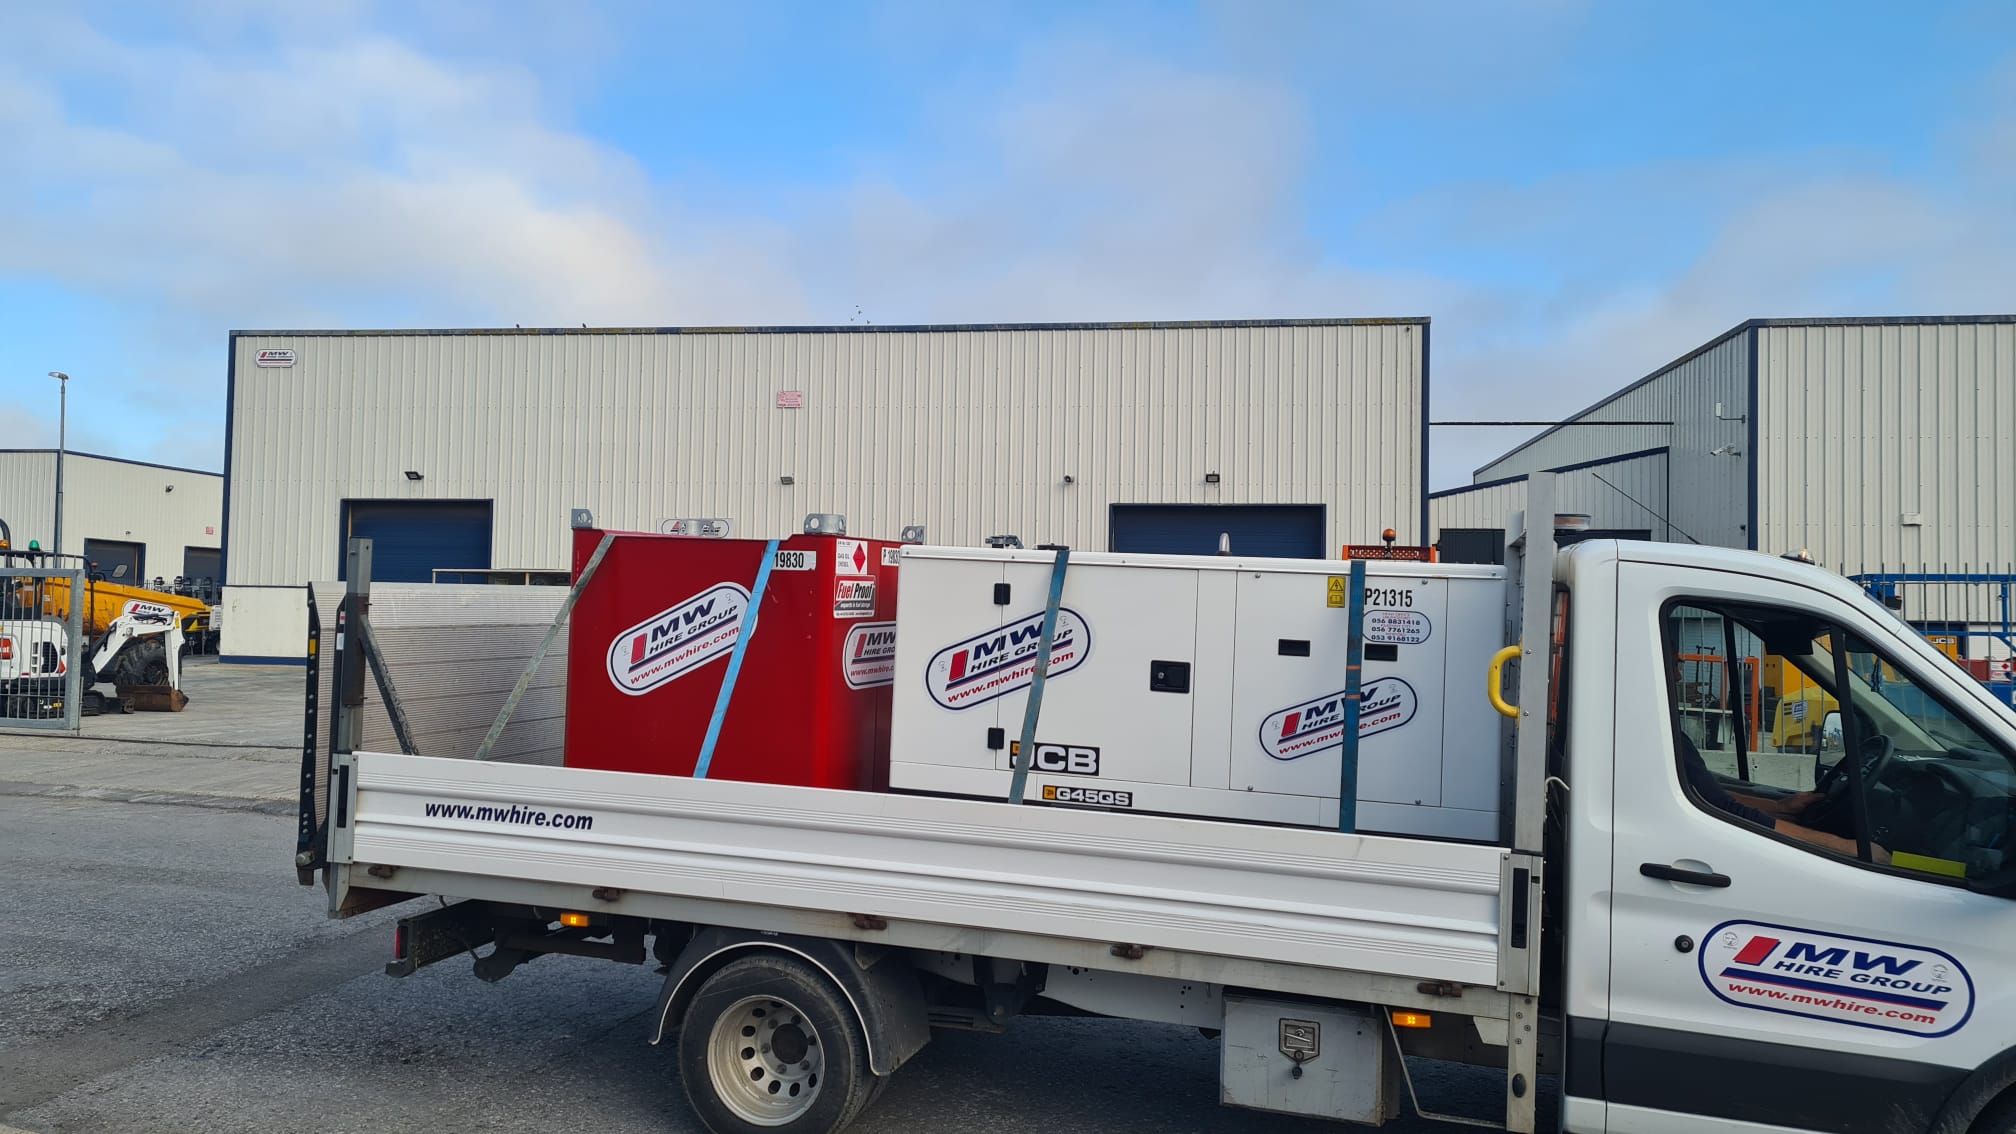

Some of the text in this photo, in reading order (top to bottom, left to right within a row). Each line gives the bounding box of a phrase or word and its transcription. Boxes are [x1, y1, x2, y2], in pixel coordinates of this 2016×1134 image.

[775, 551, 804, 569] 19830
[837, 582, 872, 599] Fuel Proof
[1364, 588, 1413, 607] P21315
[139, 604, 165, 613] MW
[651, 597, 716, 643] MW
[649, 605, 738, 655] HIRE GROUP
[867, 631, 896, 646] MW
[973, 621, 1045, 661] MW
[630, 625, 740, 685] www.mwhire.com
[863, 648, 881, 656] HIRE
[970, 628, 1073, 673] HIRE GRUP
[1278, 712, 1402, 755] www.mwe.com
[1301, 713, 1341, 730] HIRE
[1056, 787, 1130, 806] G45QS
[424, 802, 593, 830] www.mwhire.com
[1783, 942, 1923, 976] MW
[1773, 960, 1843, 980] HIRE
[1849, 973, 1952, 996] GROUP
[1728, 981, 1936, 1025] www.mwhire.com
